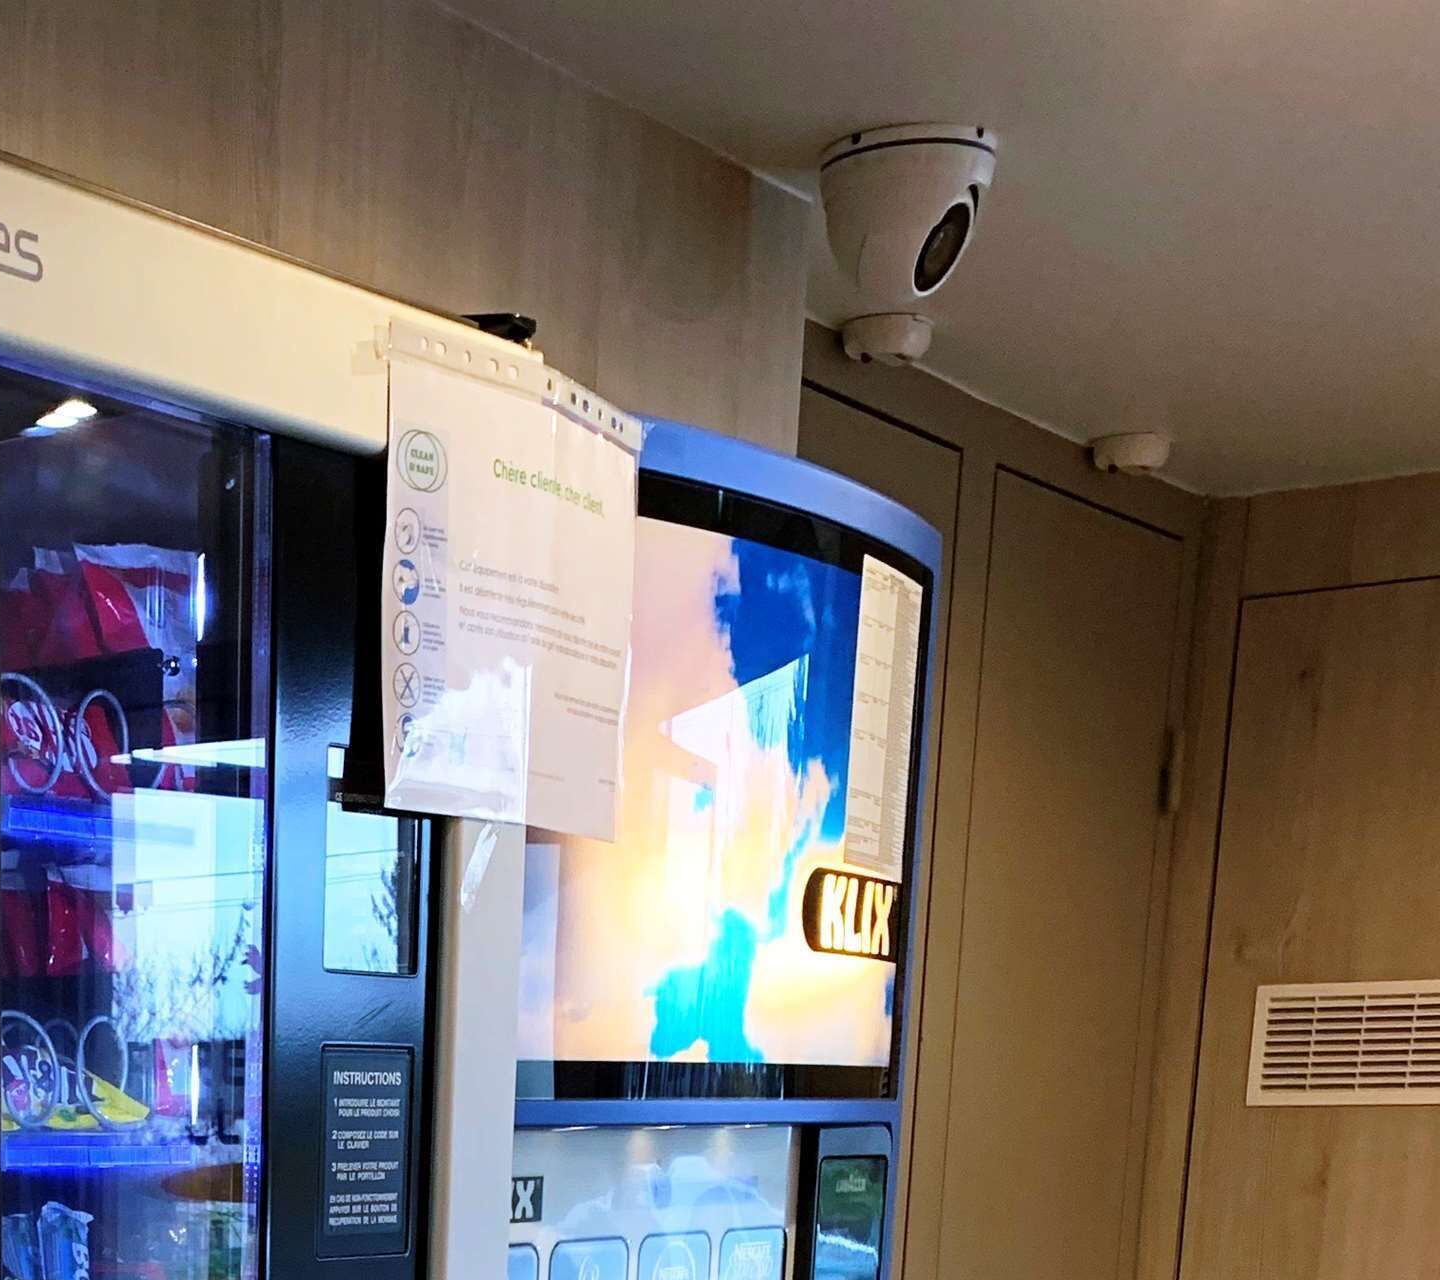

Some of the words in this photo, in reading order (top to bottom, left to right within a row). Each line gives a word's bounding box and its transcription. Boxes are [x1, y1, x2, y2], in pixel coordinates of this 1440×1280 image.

[820, 872, 894, 957] KLIX
[333, 1071, 402, 1086] INSTRUCTIONS
[331, 1130, 338, 1140] 2
[331, 1162, 337, 1172] 3
